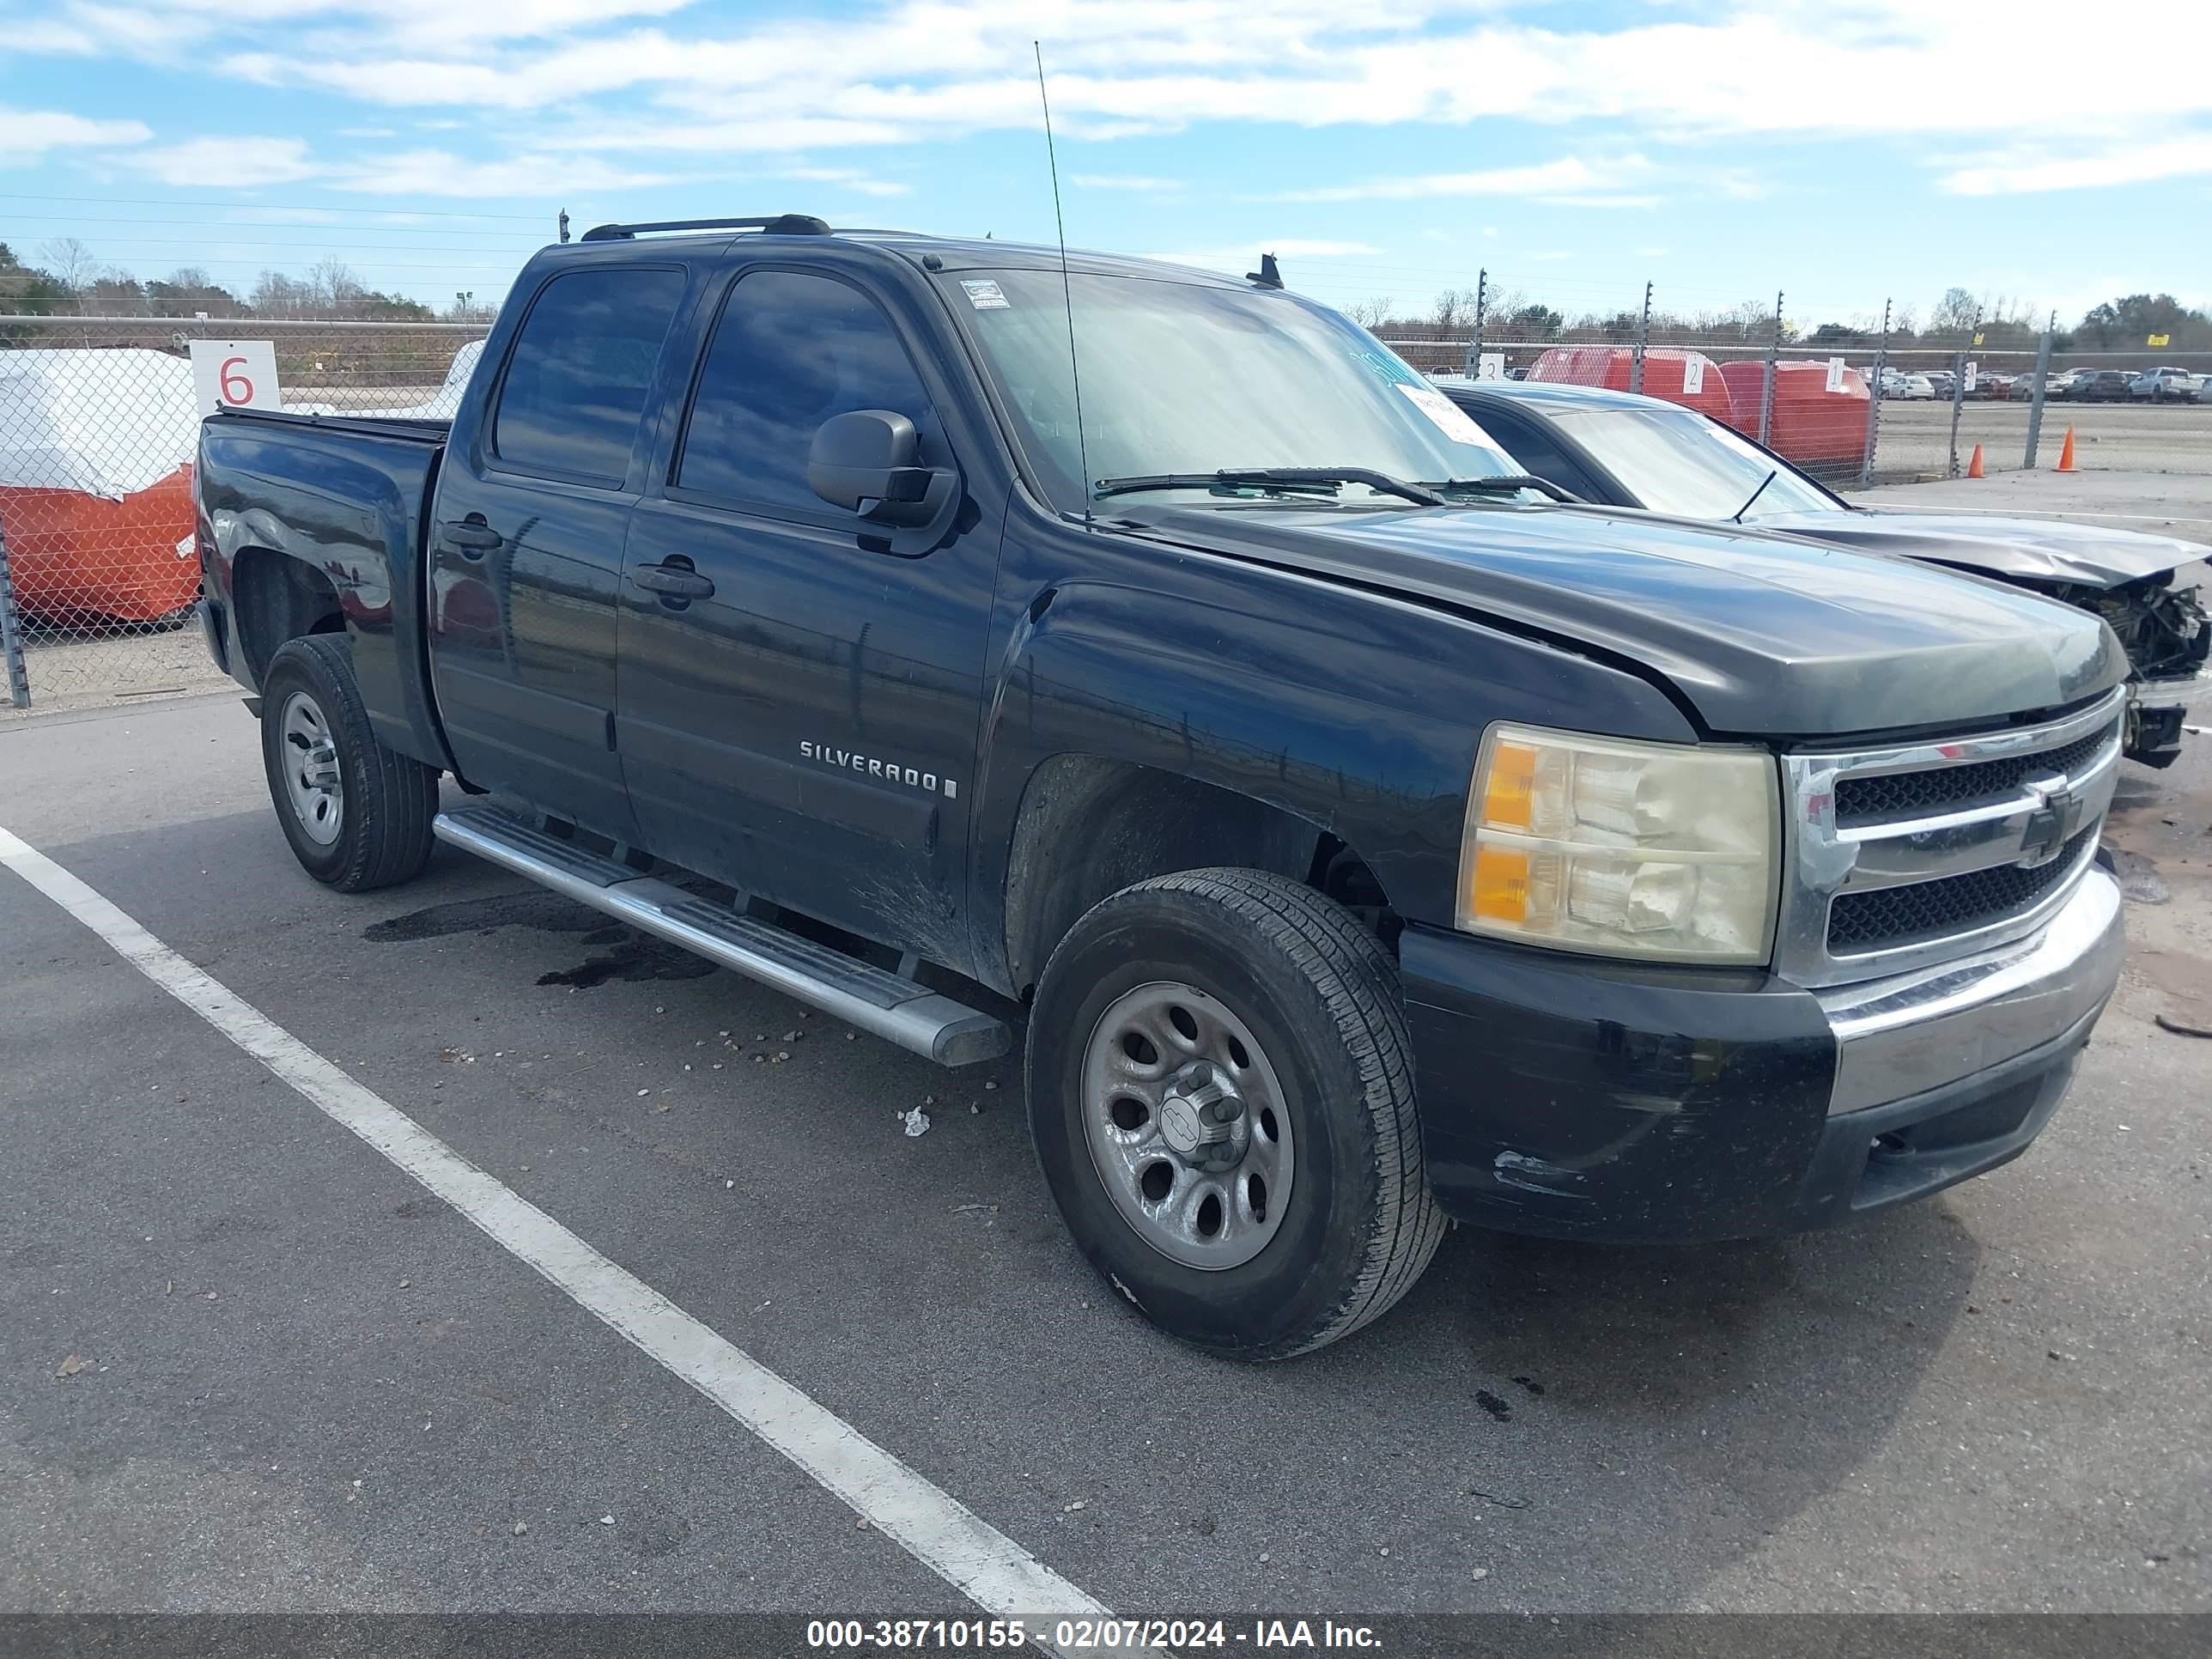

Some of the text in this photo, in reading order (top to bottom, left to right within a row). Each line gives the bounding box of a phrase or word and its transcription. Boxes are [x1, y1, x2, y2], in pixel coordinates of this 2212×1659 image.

[220, 357, 254, 405] 6
[1689, 363, 1698, 386] 2
[1831, 363, 1838, 385] 1
[799, 740, 937, 791] SILVERADO
